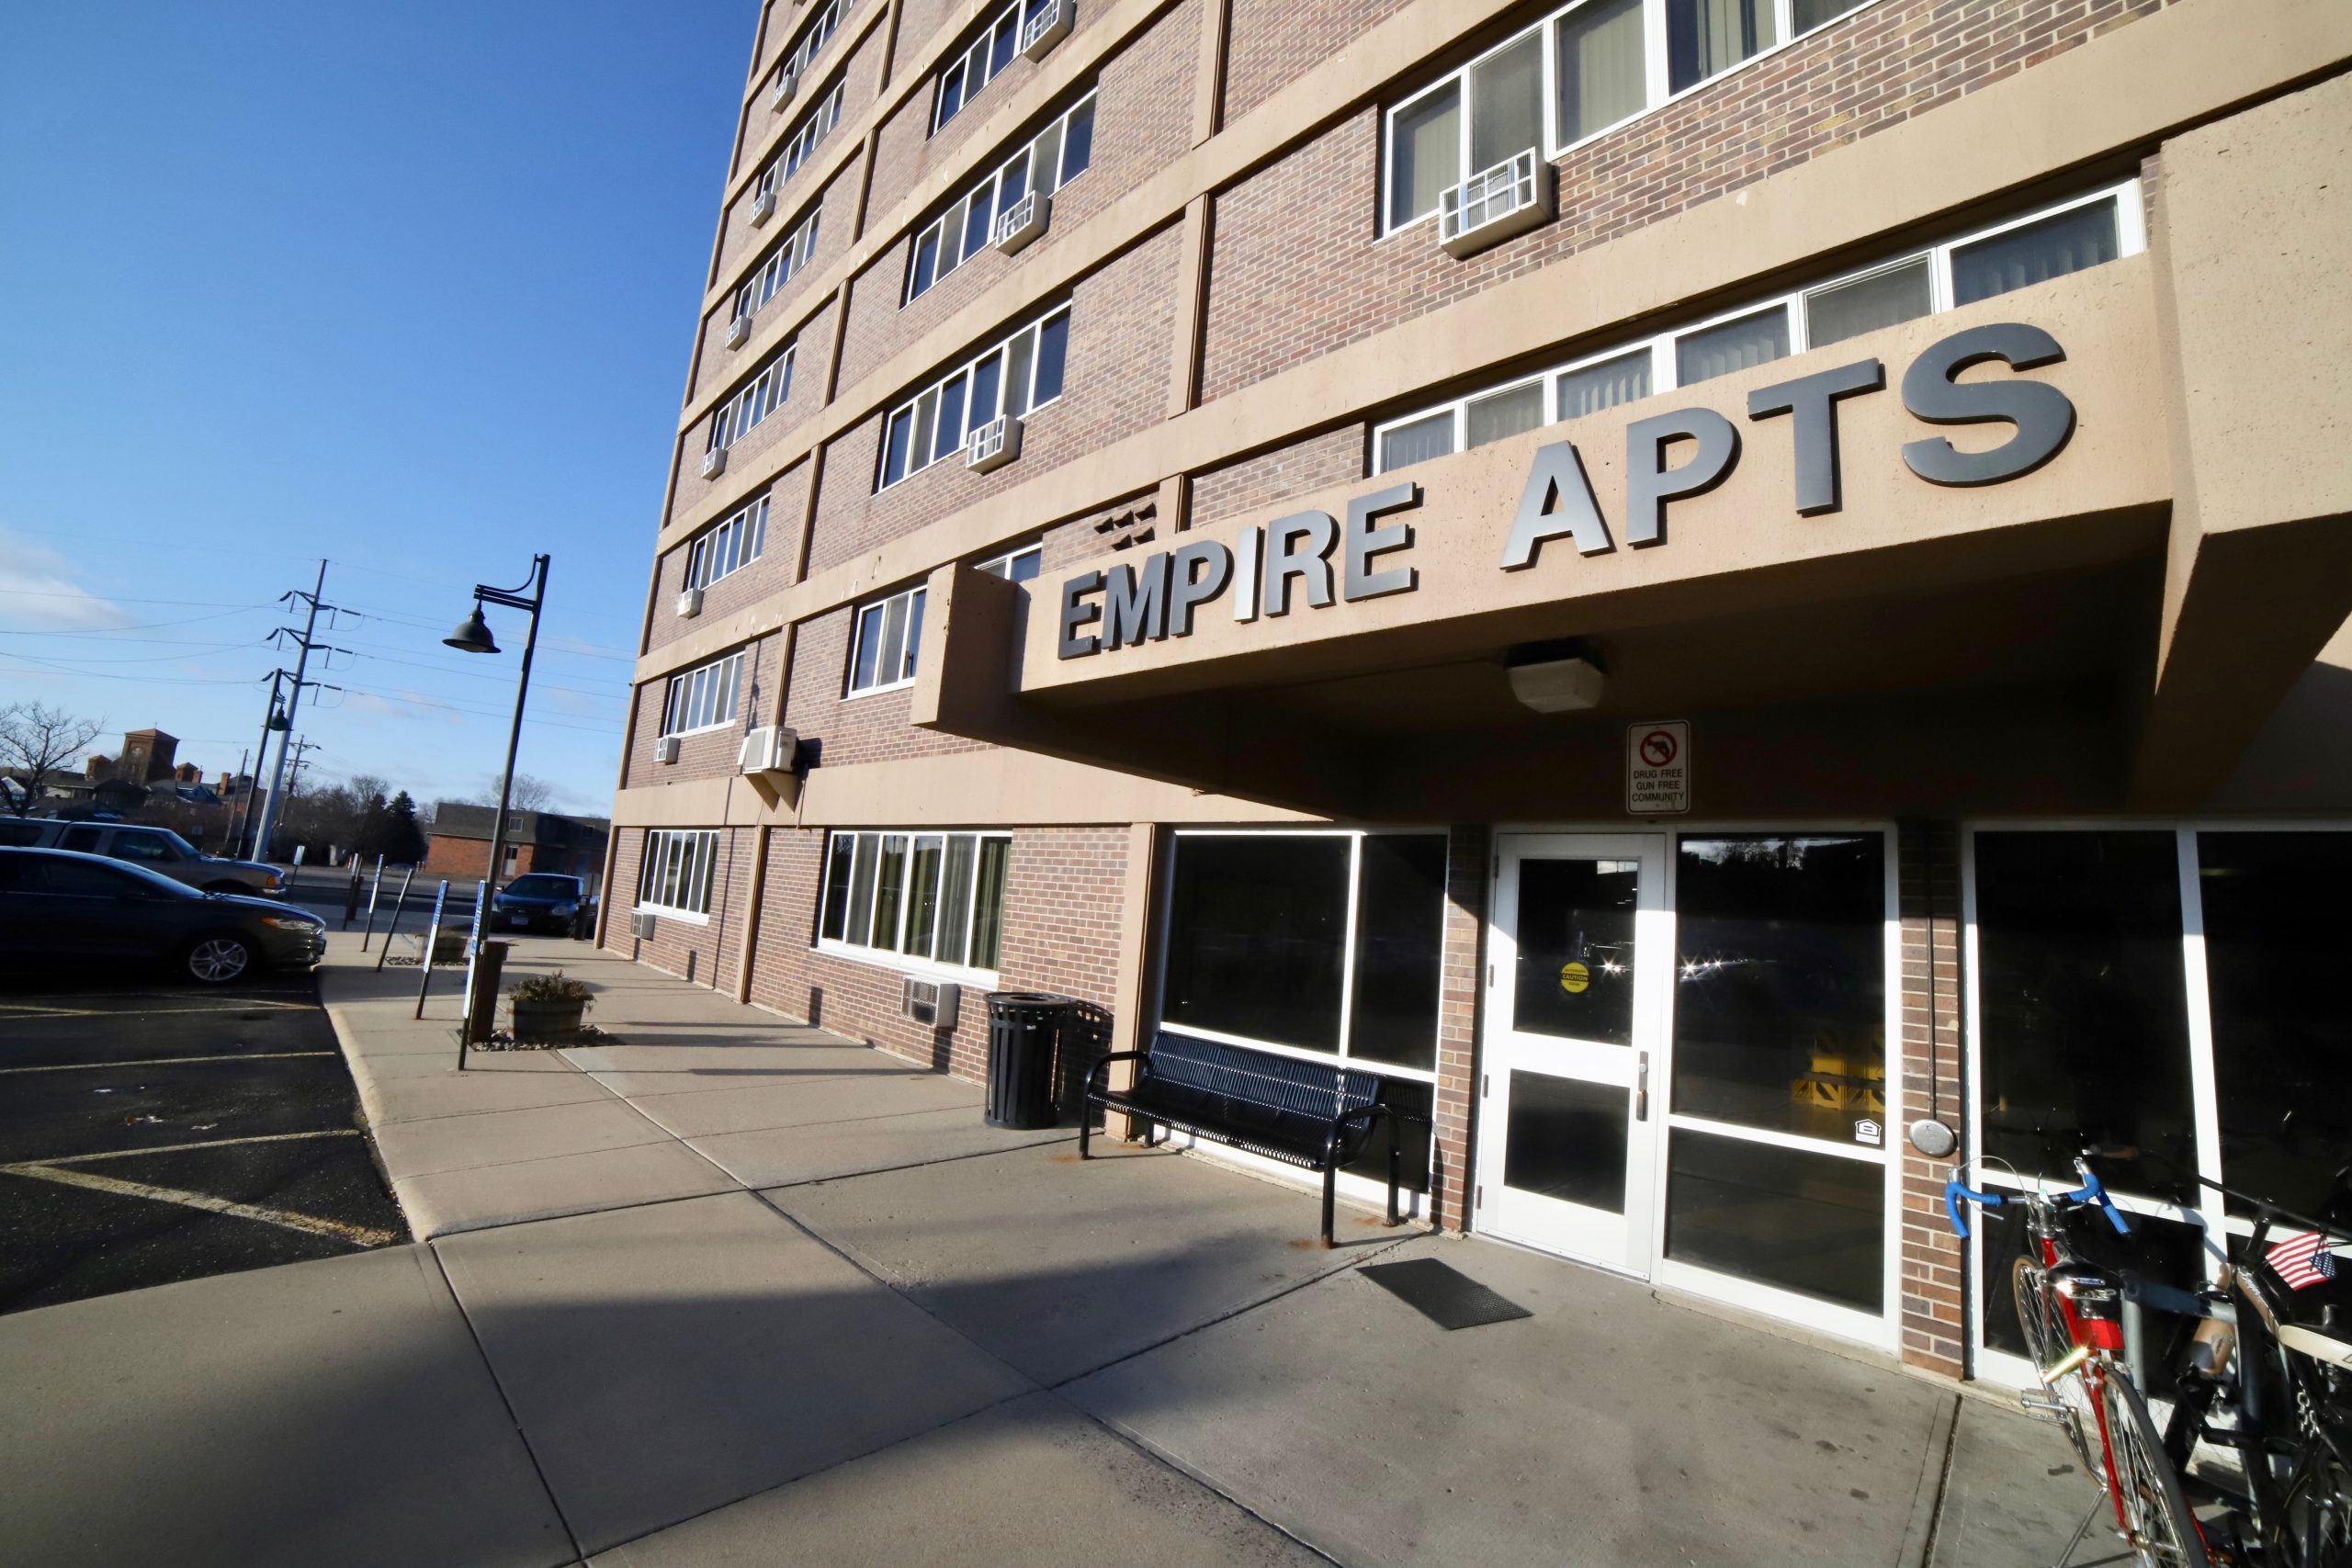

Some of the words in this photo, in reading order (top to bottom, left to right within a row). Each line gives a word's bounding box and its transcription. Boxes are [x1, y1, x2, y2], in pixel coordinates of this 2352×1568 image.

[1057, 481, 1424, 660] EMPIRE
[1499, 321, 2077, 570] APTS
[1634, 770, 1657, 779] DRUG
[1661, 768, 1682, 778] FREE
[1636, 782, 1655, 790] GUN
[1657, 780, 1679, 790] FREE
[1632, 792, 1684, 802] COMMUNITY
